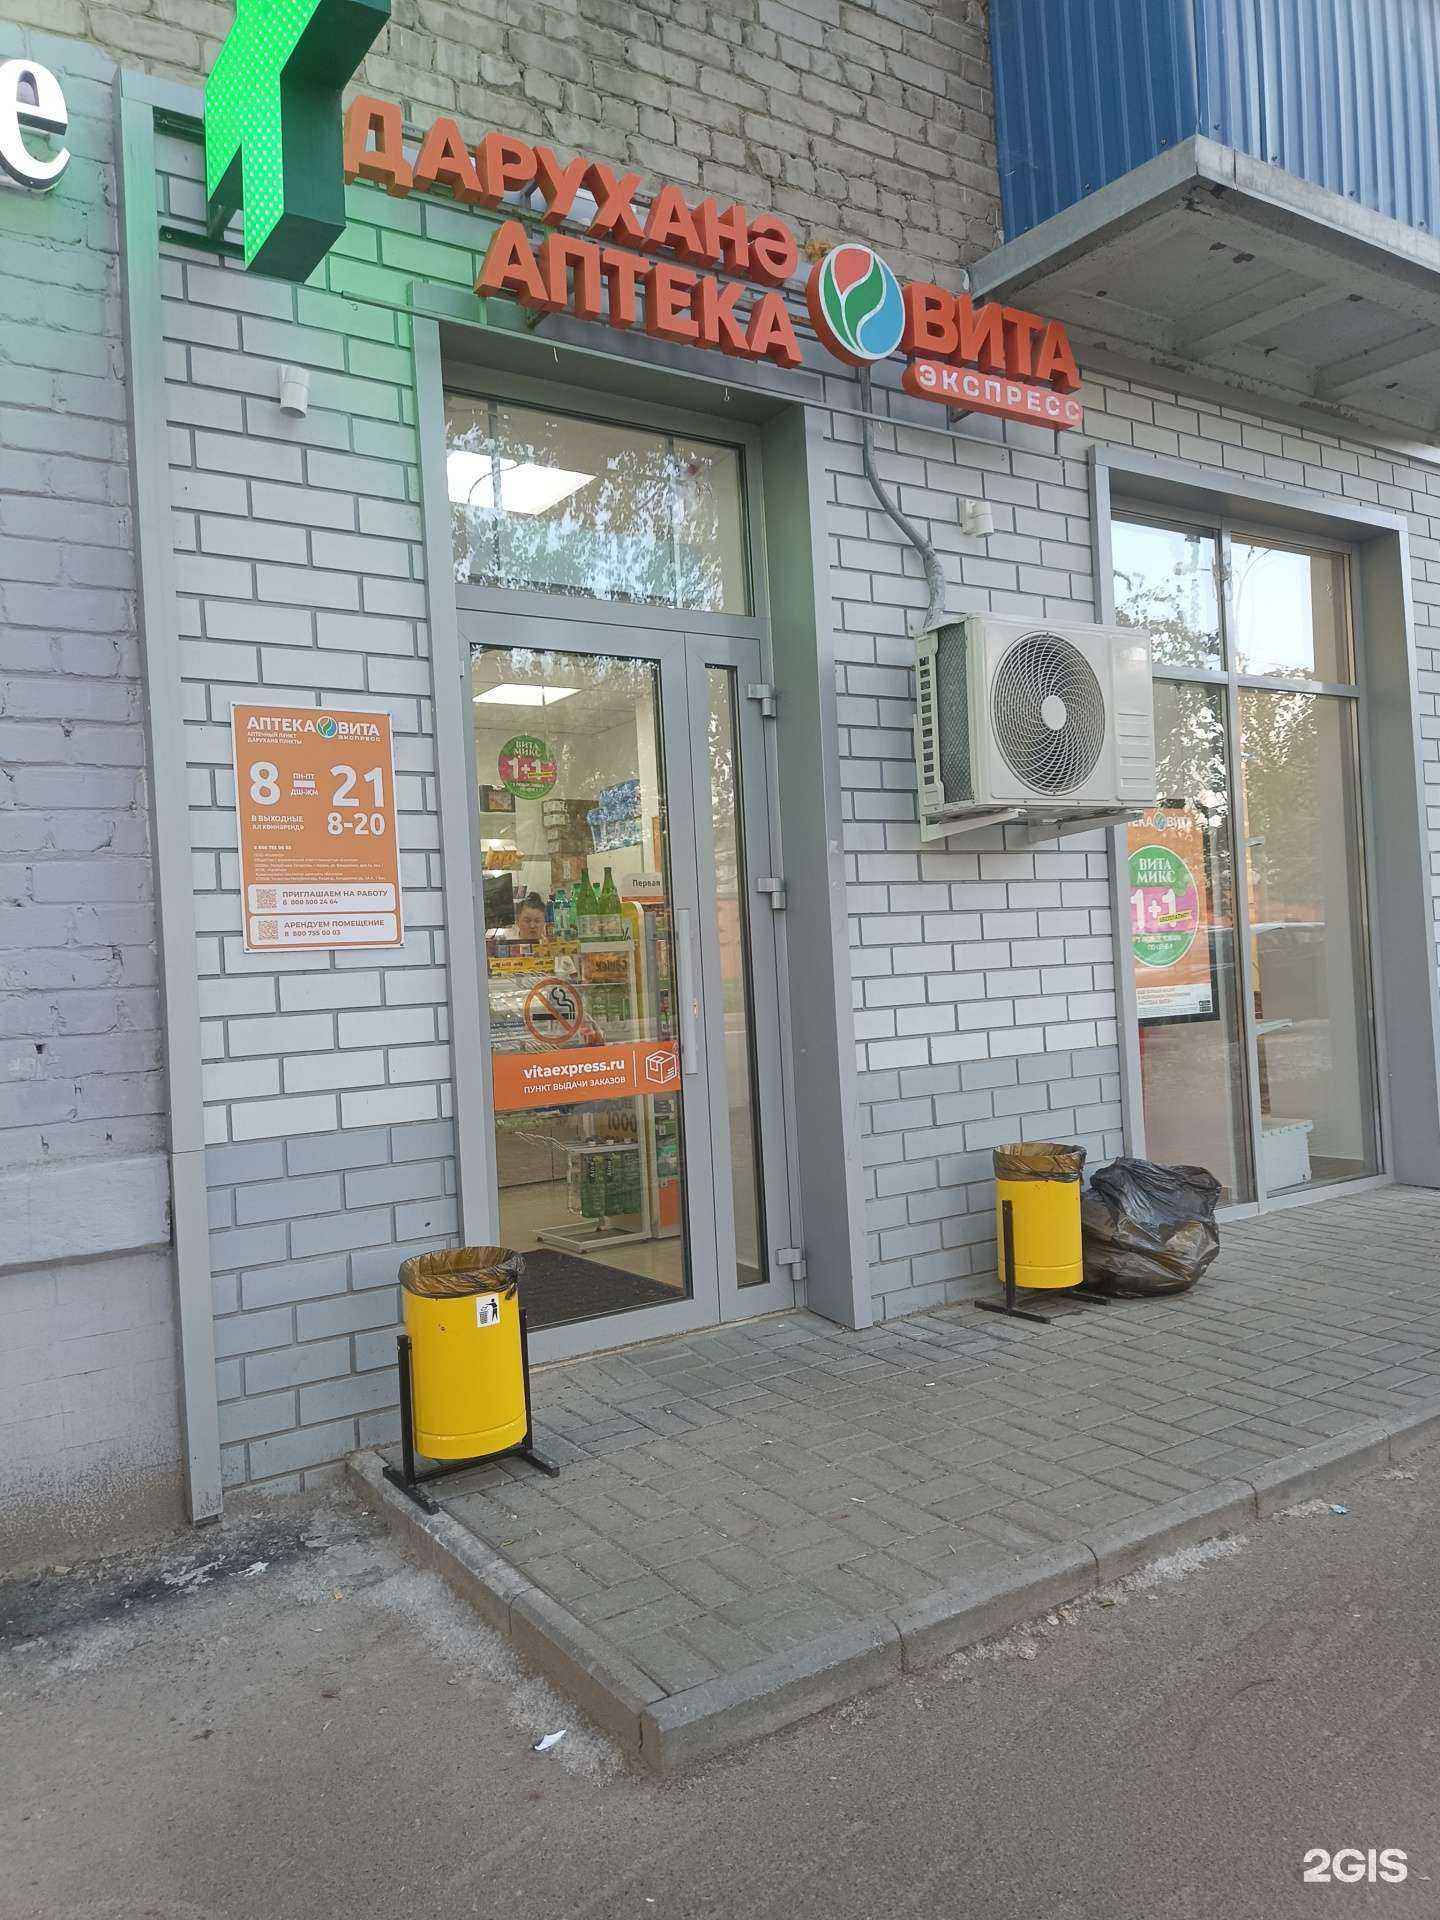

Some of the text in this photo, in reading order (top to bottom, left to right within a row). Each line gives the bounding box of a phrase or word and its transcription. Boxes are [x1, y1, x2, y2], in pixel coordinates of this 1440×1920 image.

[344, 94, 798, 286] ДАРУХАНӘ
[474, 219, 1081, 393] АПТЕКА ВИТА
[918, 364, 1081, 421] ЭКСПРЕСС
[247, 716, 380, 737] АПТЕКА ВИТА
[249, 761, 281, 806] 8
[330, 764, 385, 808] 21
[258, 815, 305, 824] ВЫХОДНЫЕ
[327, 812, 386, 836] 8-20
[1139, 858, 1172, 871] ВИТА
[632, 879, 661, 888] Первая
[1137, 870, 1176, 883] МИКС
[282, 890, 341, 899] ПРИГЛАШАЕМ
[357, 889, 388, 897] РАБОТУ
[1130, 888, 1177, 929] 1+1
[284, 919, 385, 929] АРЕНДУЕМ ПОМЕЩЕНИЕ
[522, 1059, 626, 1080] vitaexpress.ru
[524, 1076, 627, 1094] ПУНКТ ВЫДАЧИ ЗАКАЗОВ
